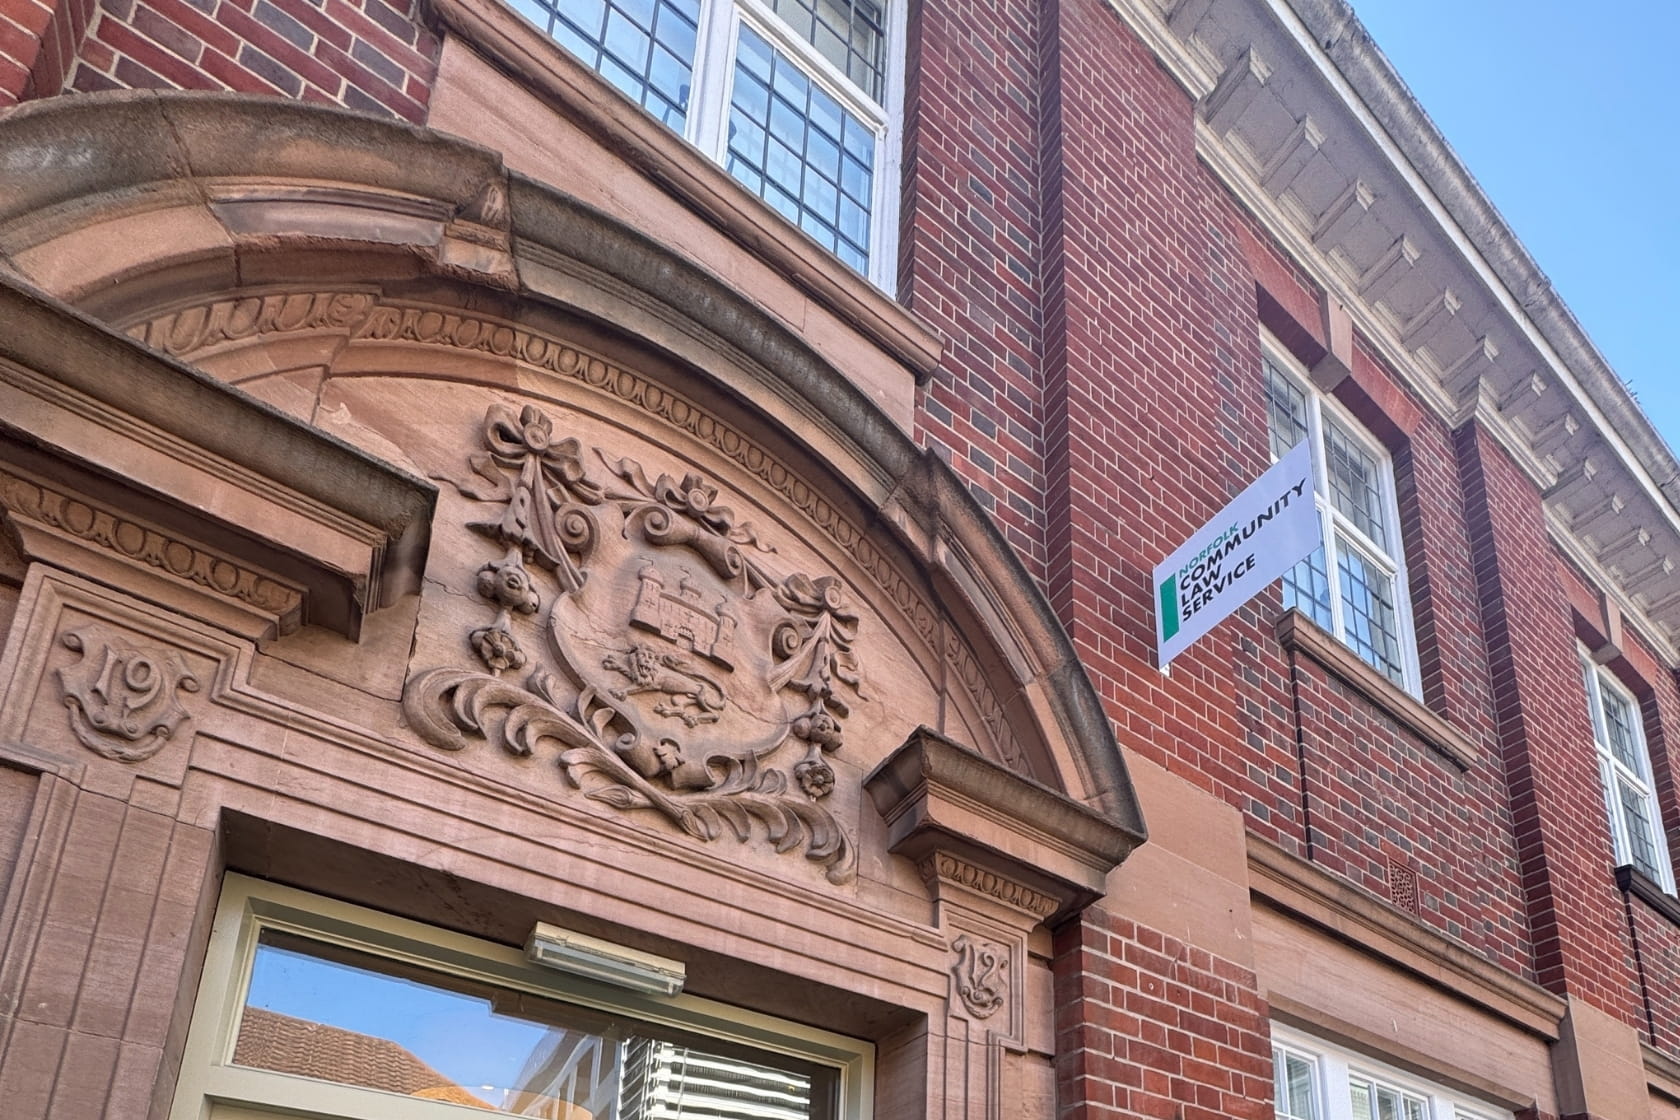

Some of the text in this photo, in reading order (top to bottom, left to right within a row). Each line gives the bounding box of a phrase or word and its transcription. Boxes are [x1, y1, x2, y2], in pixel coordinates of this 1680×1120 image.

[1179, 521, 1239, 578] NORFOLK
[1180, 477, 1306, 591] COMMUNITY
[1181, 563, 1222, 607] LAW
[1183, 553, 1256, 622] SERVICE
[91, 644, 162, 710] 19
